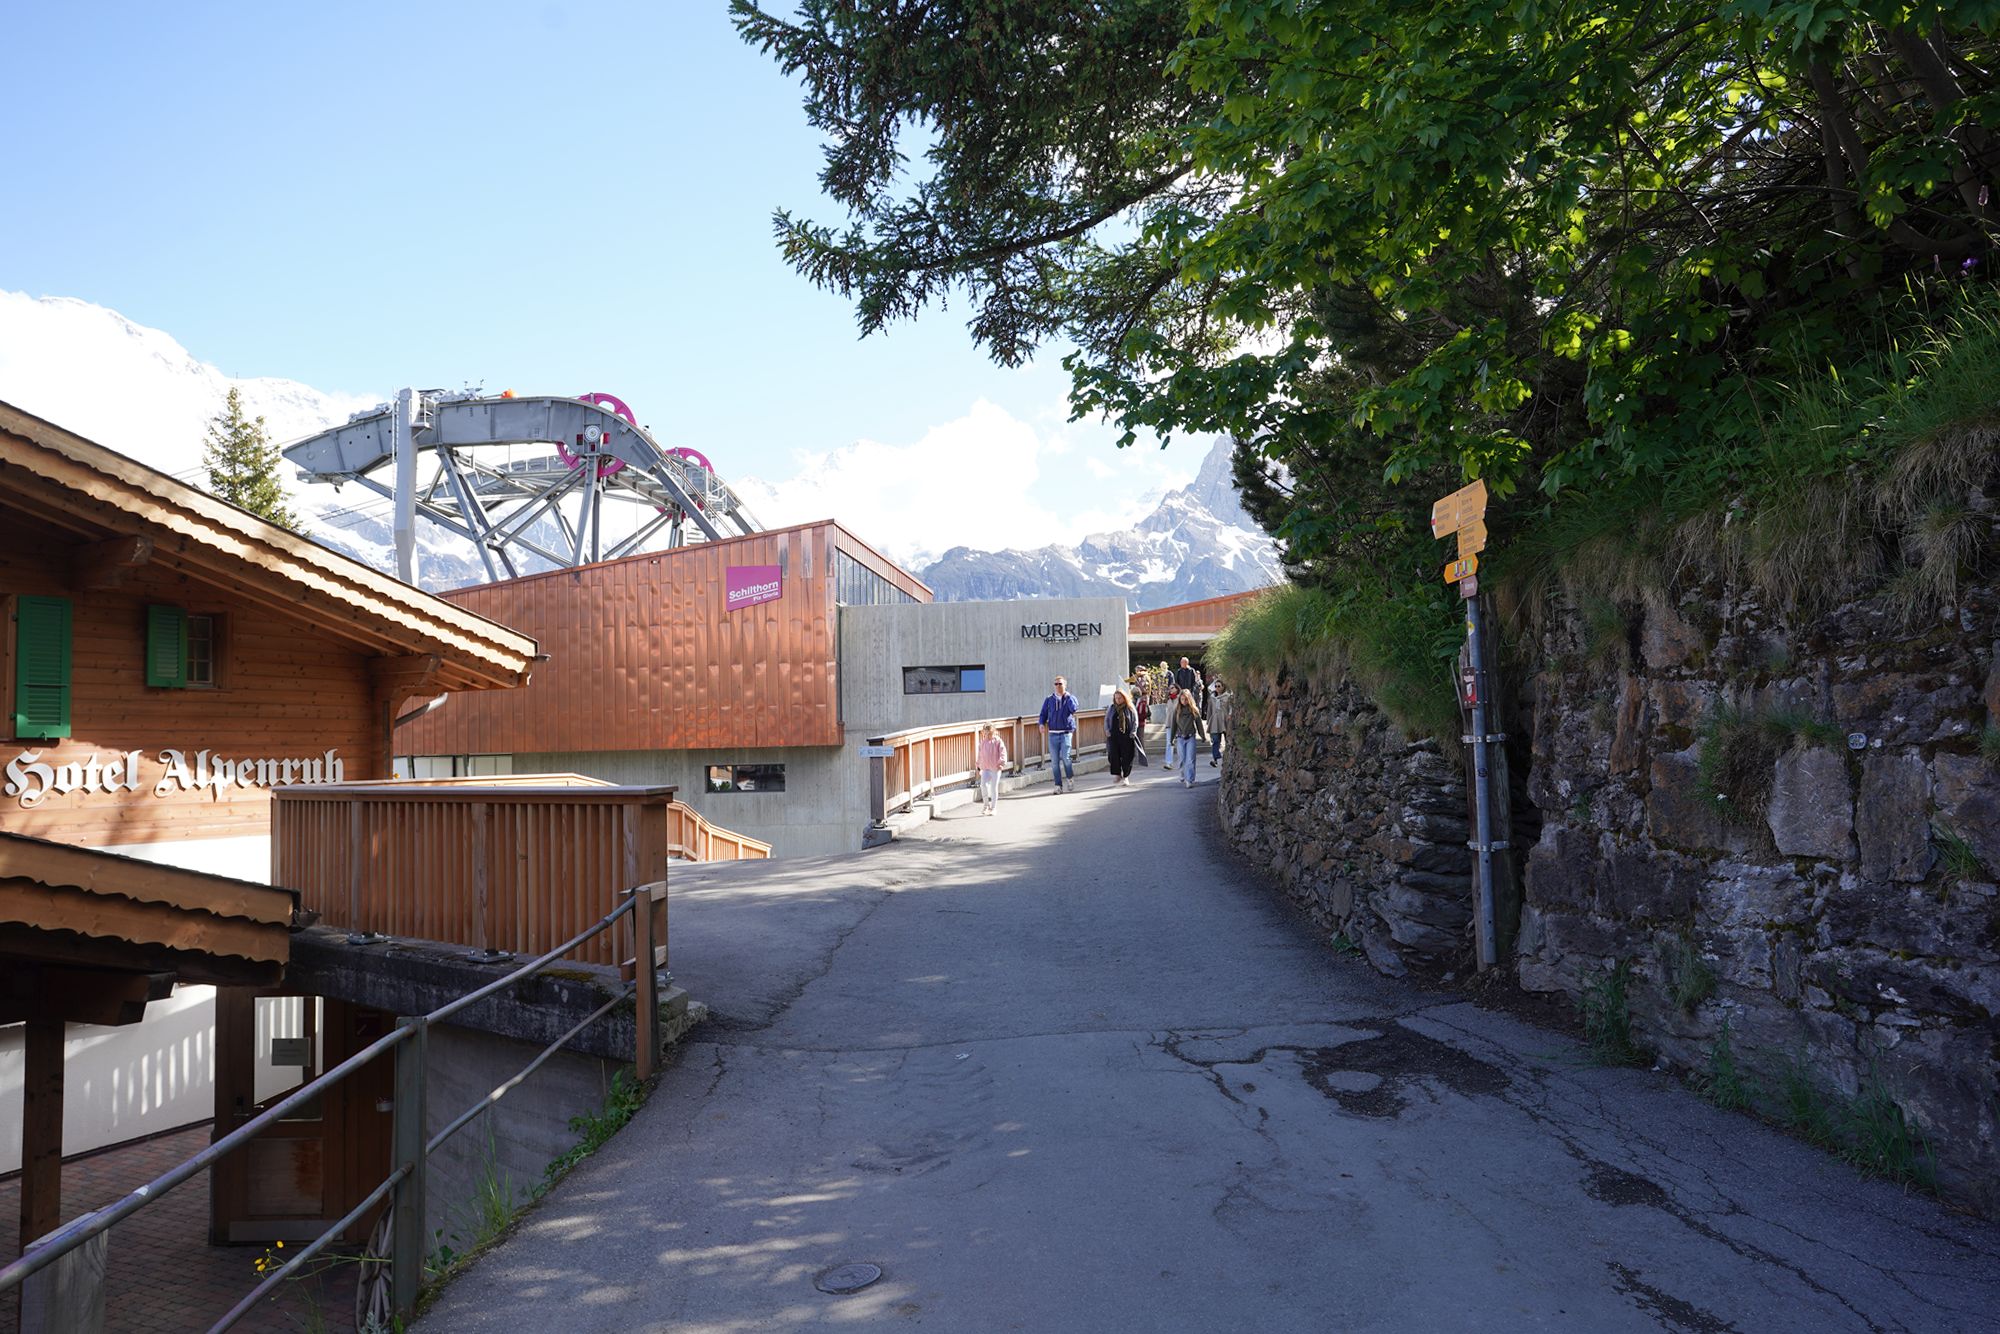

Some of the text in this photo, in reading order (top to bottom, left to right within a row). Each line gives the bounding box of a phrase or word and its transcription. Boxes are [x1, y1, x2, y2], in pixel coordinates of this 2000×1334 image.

[729, 581, 779, 599] Schilthorn
[1021, 622, 1102, 638] MÜRREN
[5, 749, 345, 809] Hotel Alpenruh
